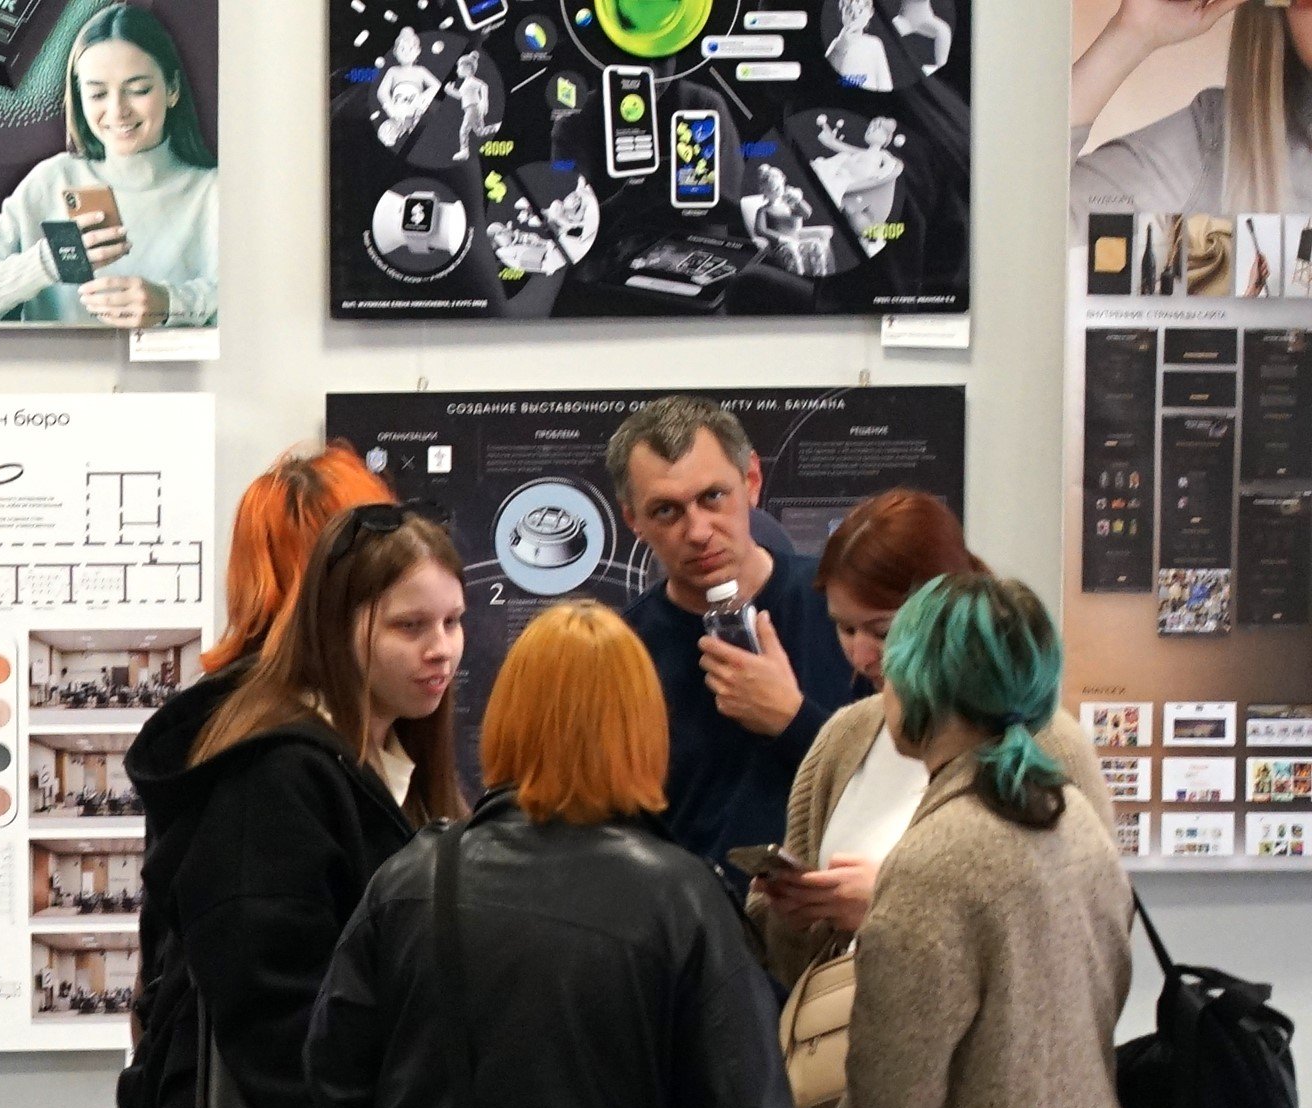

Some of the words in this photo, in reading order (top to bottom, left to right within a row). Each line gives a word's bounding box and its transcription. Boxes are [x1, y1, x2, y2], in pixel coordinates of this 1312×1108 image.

[446, 402, 517, 415] СОЗДАНИЕ
[520, 400, 625, 414] ВЫСТАВОЧНОГО
[719, 399, 753, 411] МГТУ
[756, 399, 781, 411] ИМ.
[784, 398, 846, 411] БАУМАНА
[13, 408, 71, 430] бюро
[534, 429, 581, 440] ПРОБЛЕМА
[489, 583, 504, 605] 2
